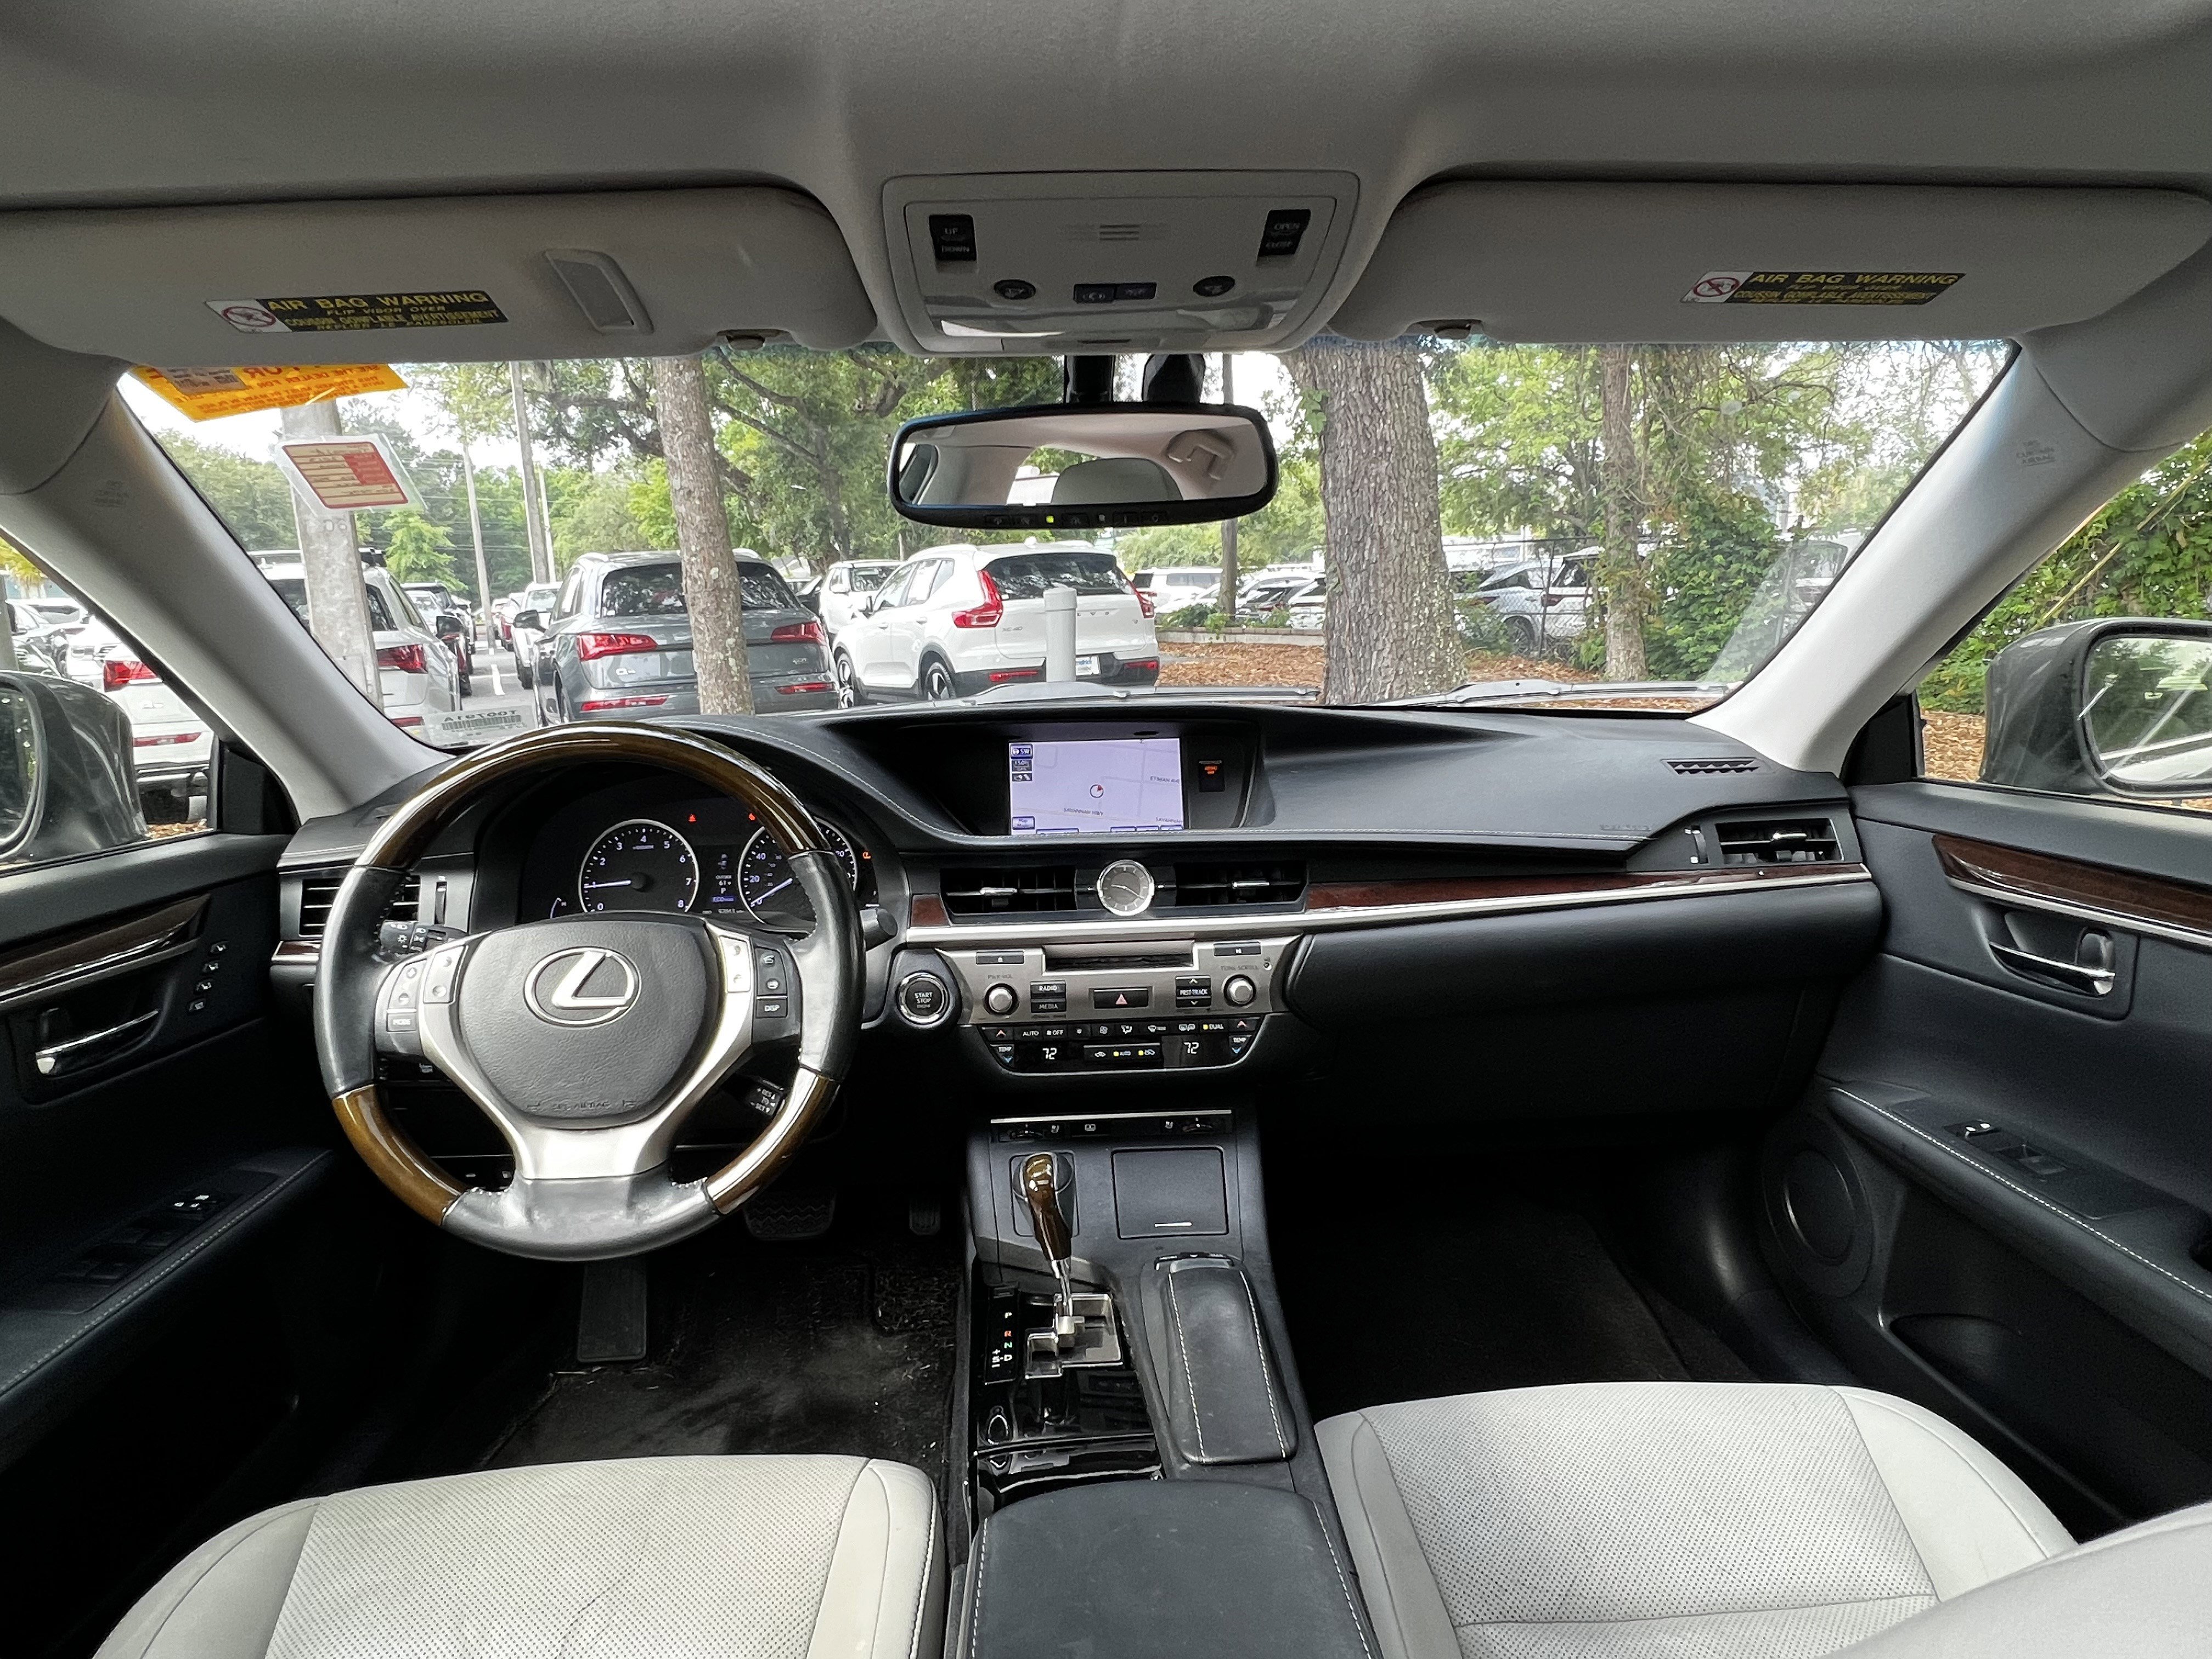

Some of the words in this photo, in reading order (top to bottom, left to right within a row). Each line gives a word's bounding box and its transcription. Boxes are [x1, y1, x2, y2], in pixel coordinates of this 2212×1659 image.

[1749, 274, 1789, 283] AIR
[1796, 274, 1845, 283] BAG
[1855, 274, 1959, 284] WARNING
[268, 300, 308, 311] AIR
[315, 297, 369, 308] BAG
[376, 292, 489, 306] WARNING
[616, 842, 623, 850] 3
[664, 840, 670, 849] 5
[679, 855, 686, 863] 6
[597, 902, 603, 911] 0
[678, 900, 684, 908] 8
[1184, 1042, 1199, 1054] 72
[1042, 1047, 1057, 1060] 72
